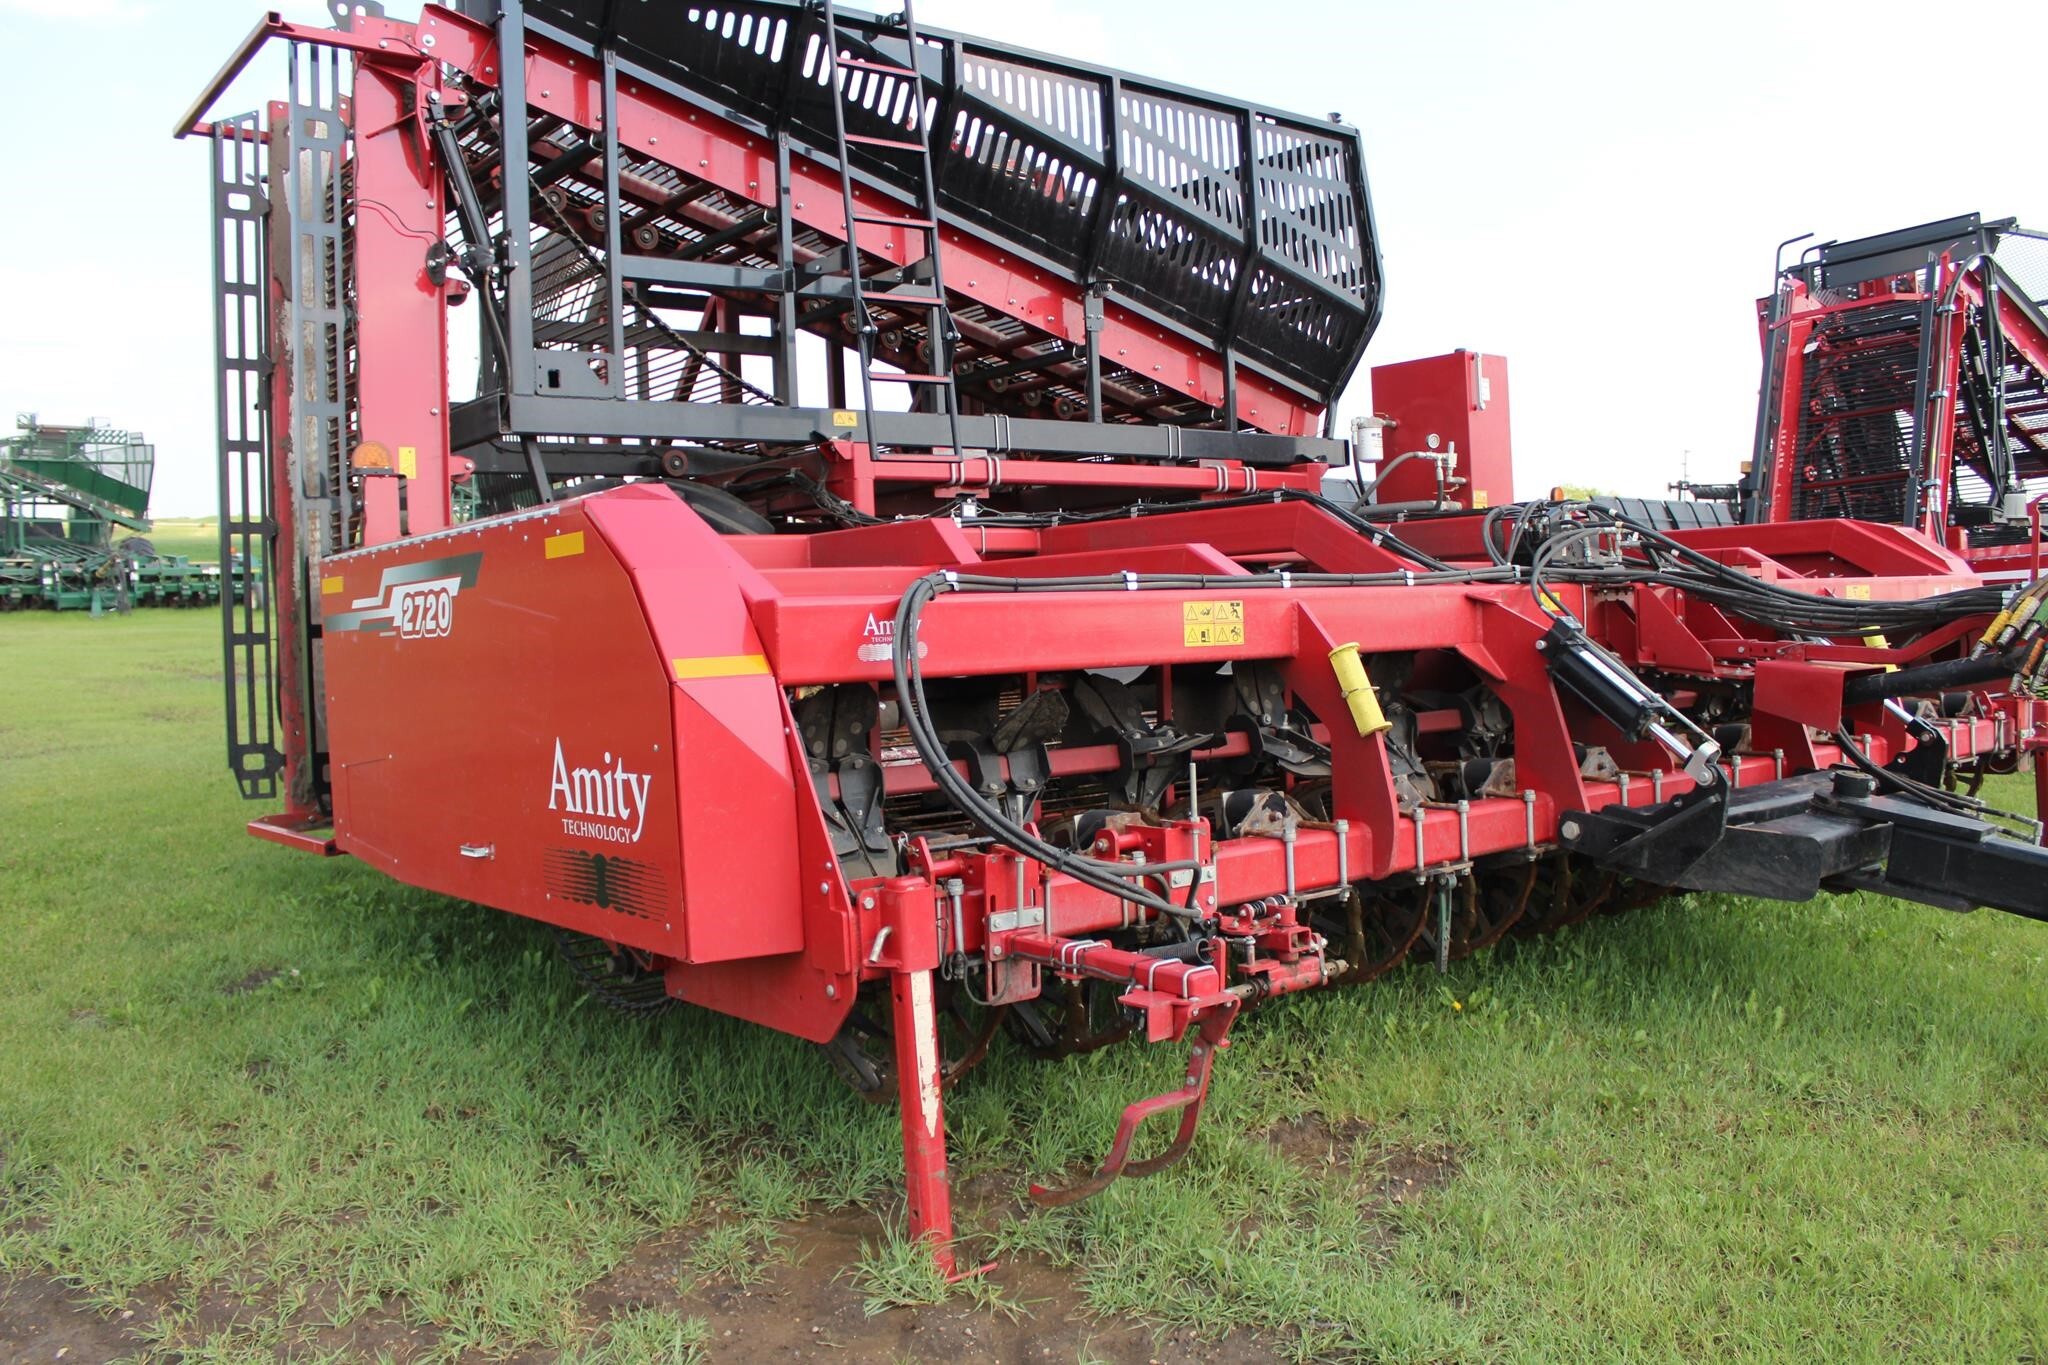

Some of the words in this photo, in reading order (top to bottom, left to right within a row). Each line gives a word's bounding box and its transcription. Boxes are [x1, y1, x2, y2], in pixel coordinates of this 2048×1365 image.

[402, 591, 451, 635] 2720
[548, 736, 652, 842] Amity
[562, 818, 631, 843] TECHNOLOGY
